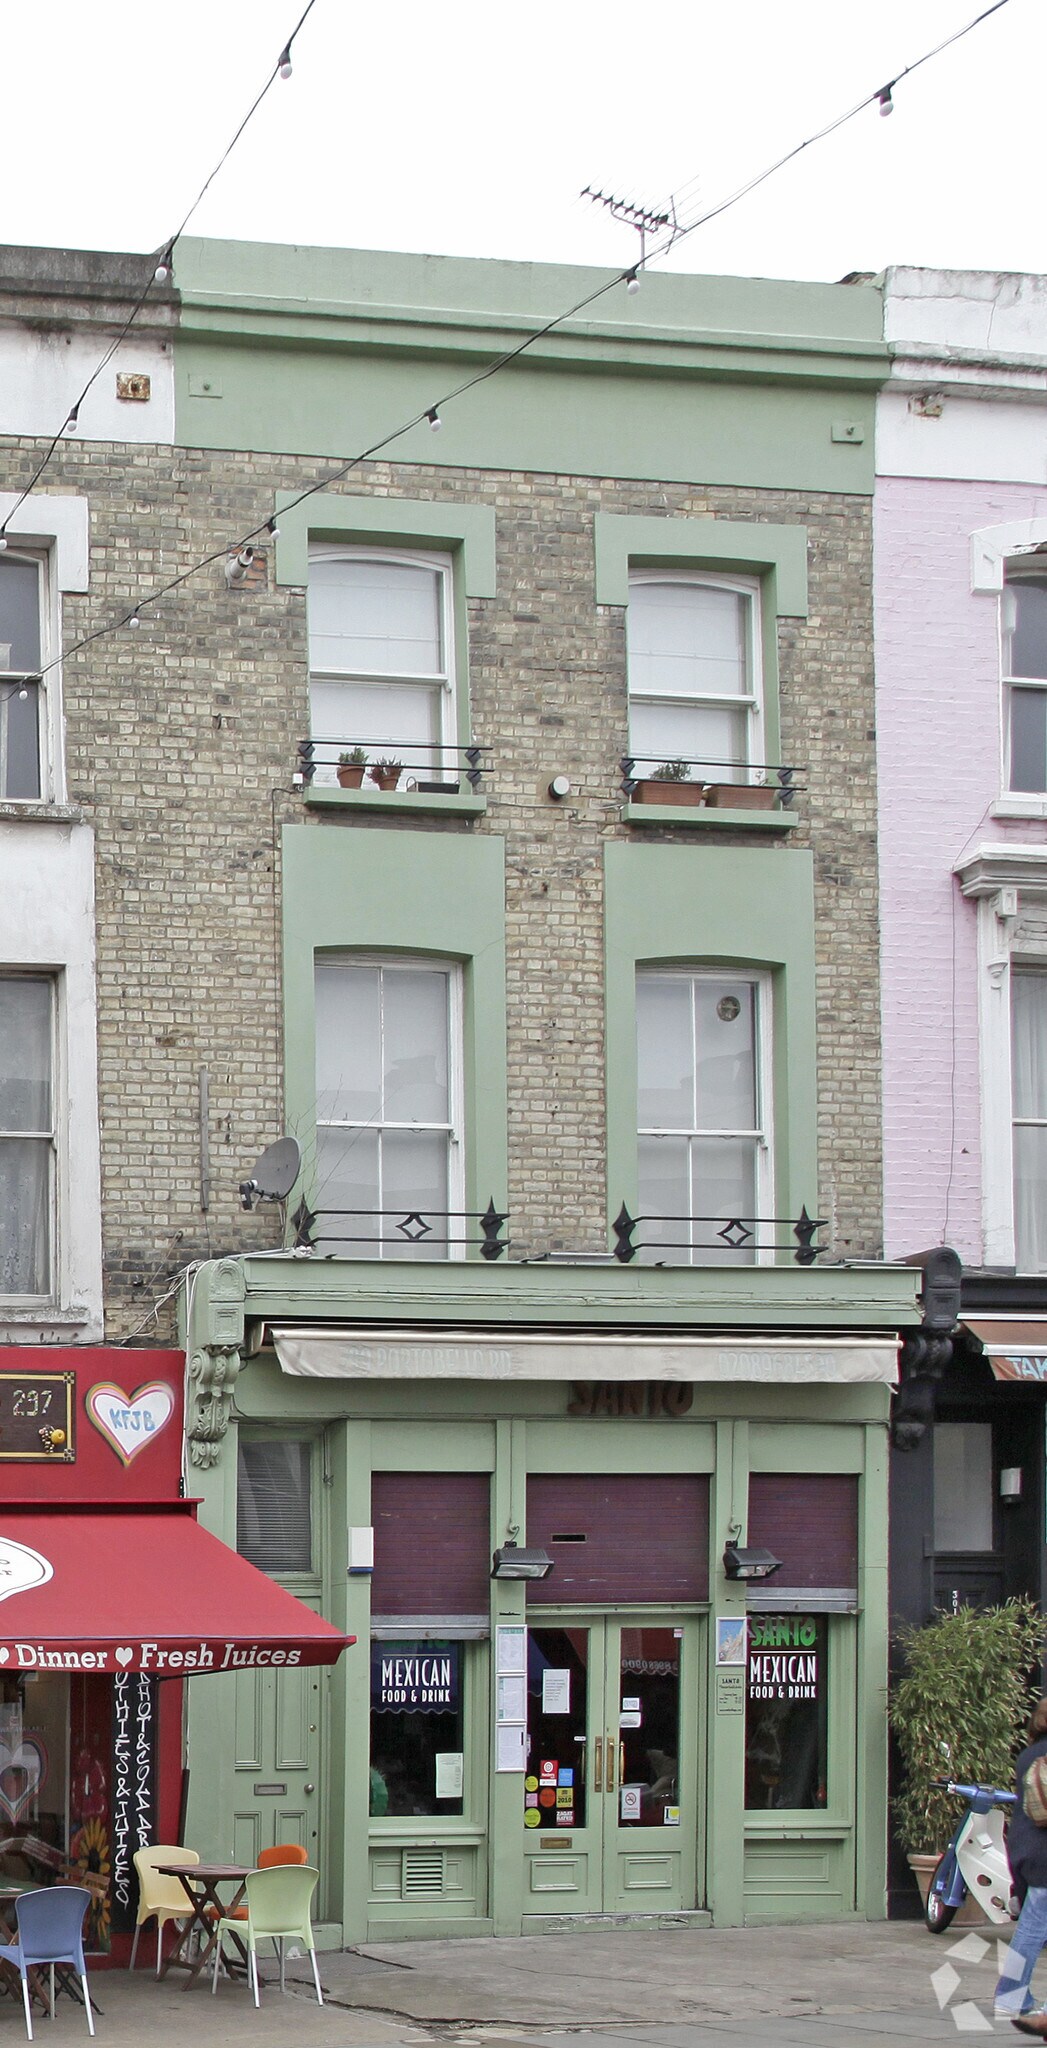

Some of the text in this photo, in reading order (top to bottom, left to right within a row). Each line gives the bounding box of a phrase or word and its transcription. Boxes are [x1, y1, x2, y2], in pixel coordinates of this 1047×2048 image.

[377, 1348, 484, 1376] PORTOBELLO
[13, 1390, 52, 1417] 297
[109, 1408, 156, 1431] KFJB
[750, 1615, 817, 1646] SANTO
[15, 1643, 301, 1668] Dinner Fresh Juices
[382, 1659, 450, 1687] MEXICAN
[750, 1656, 816, 1683] MEXICAN
[382, 1690, 450, 1703] FOOD & DRINK
[750, 1686, 774, 1698] FOOD
[778, 1686, 784, 1698] &
[788, 1686, 816, 1698] DRINK
